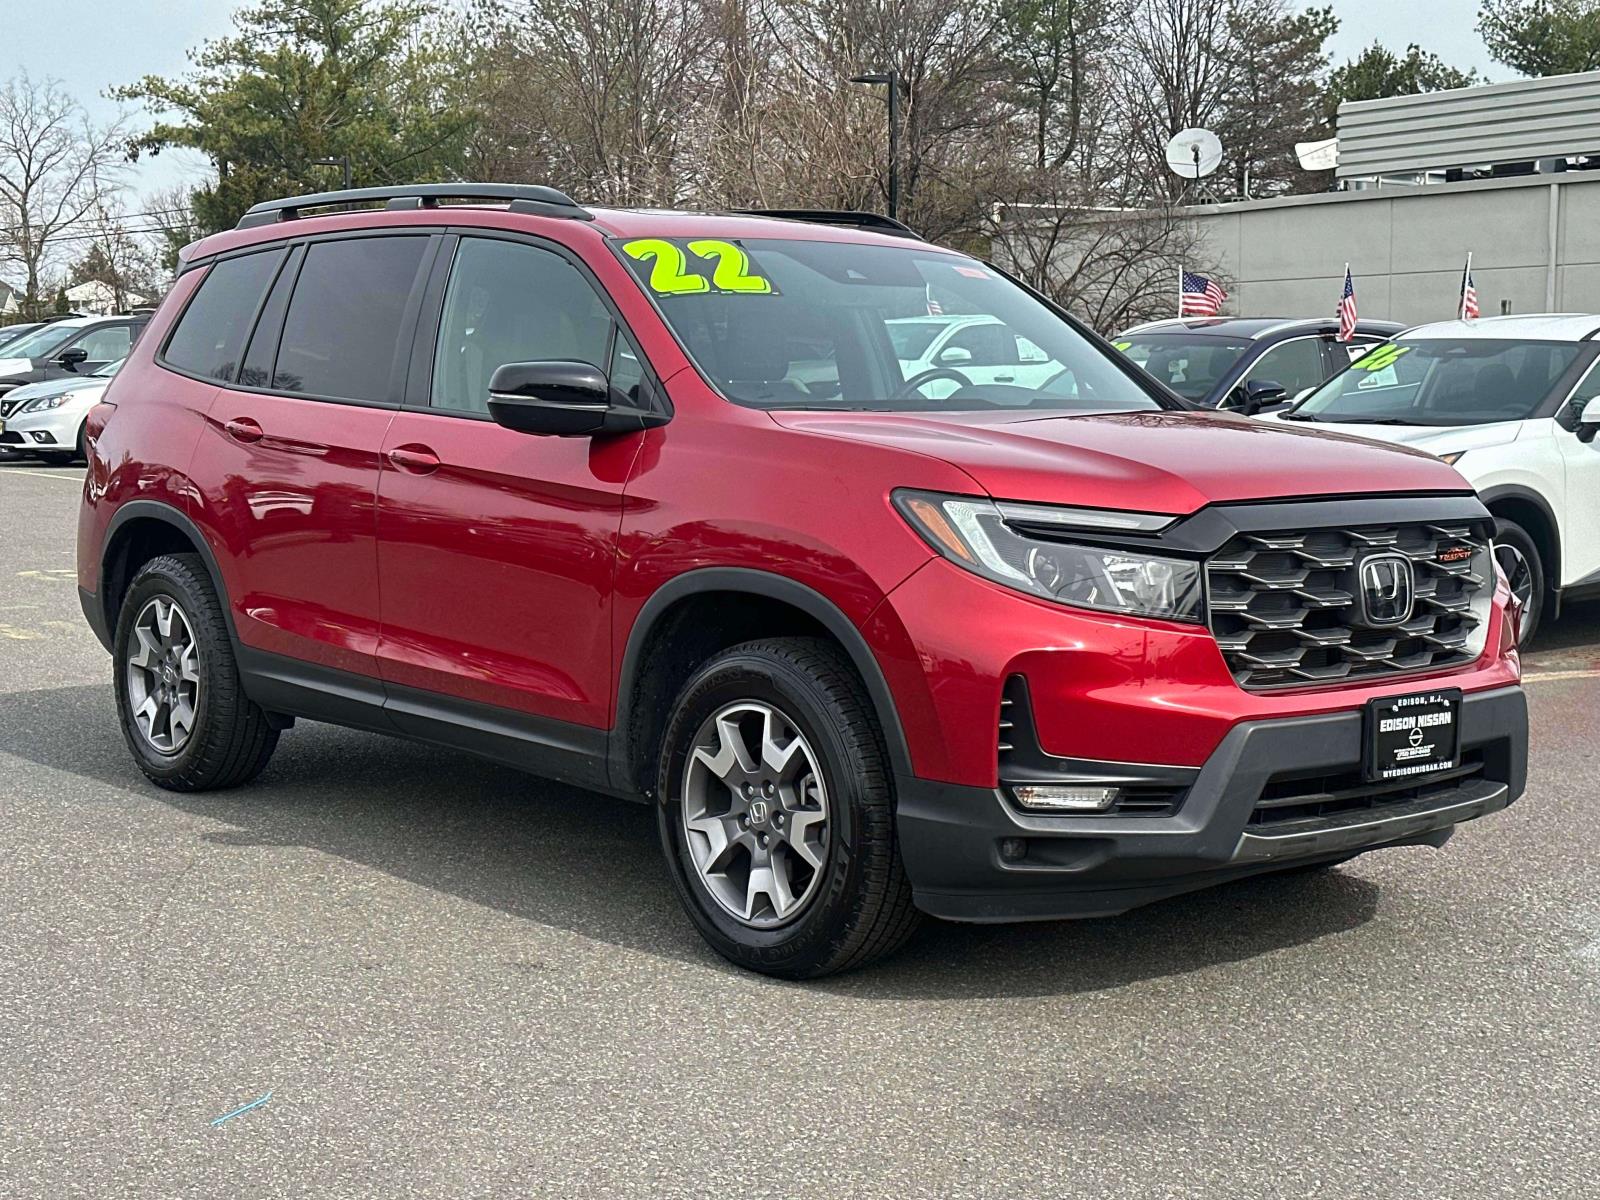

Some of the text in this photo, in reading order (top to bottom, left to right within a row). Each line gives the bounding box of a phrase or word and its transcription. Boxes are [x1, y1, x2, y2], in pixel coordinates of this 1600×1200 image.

[623, 239, 772, 295] 22
[1398, 697, 1427, 706] EDISON,
[1380, 712, 1452, 732] EDISON NISSAN
[1383, 761, 1453, 778] MYEDISONNISSAN.COM
